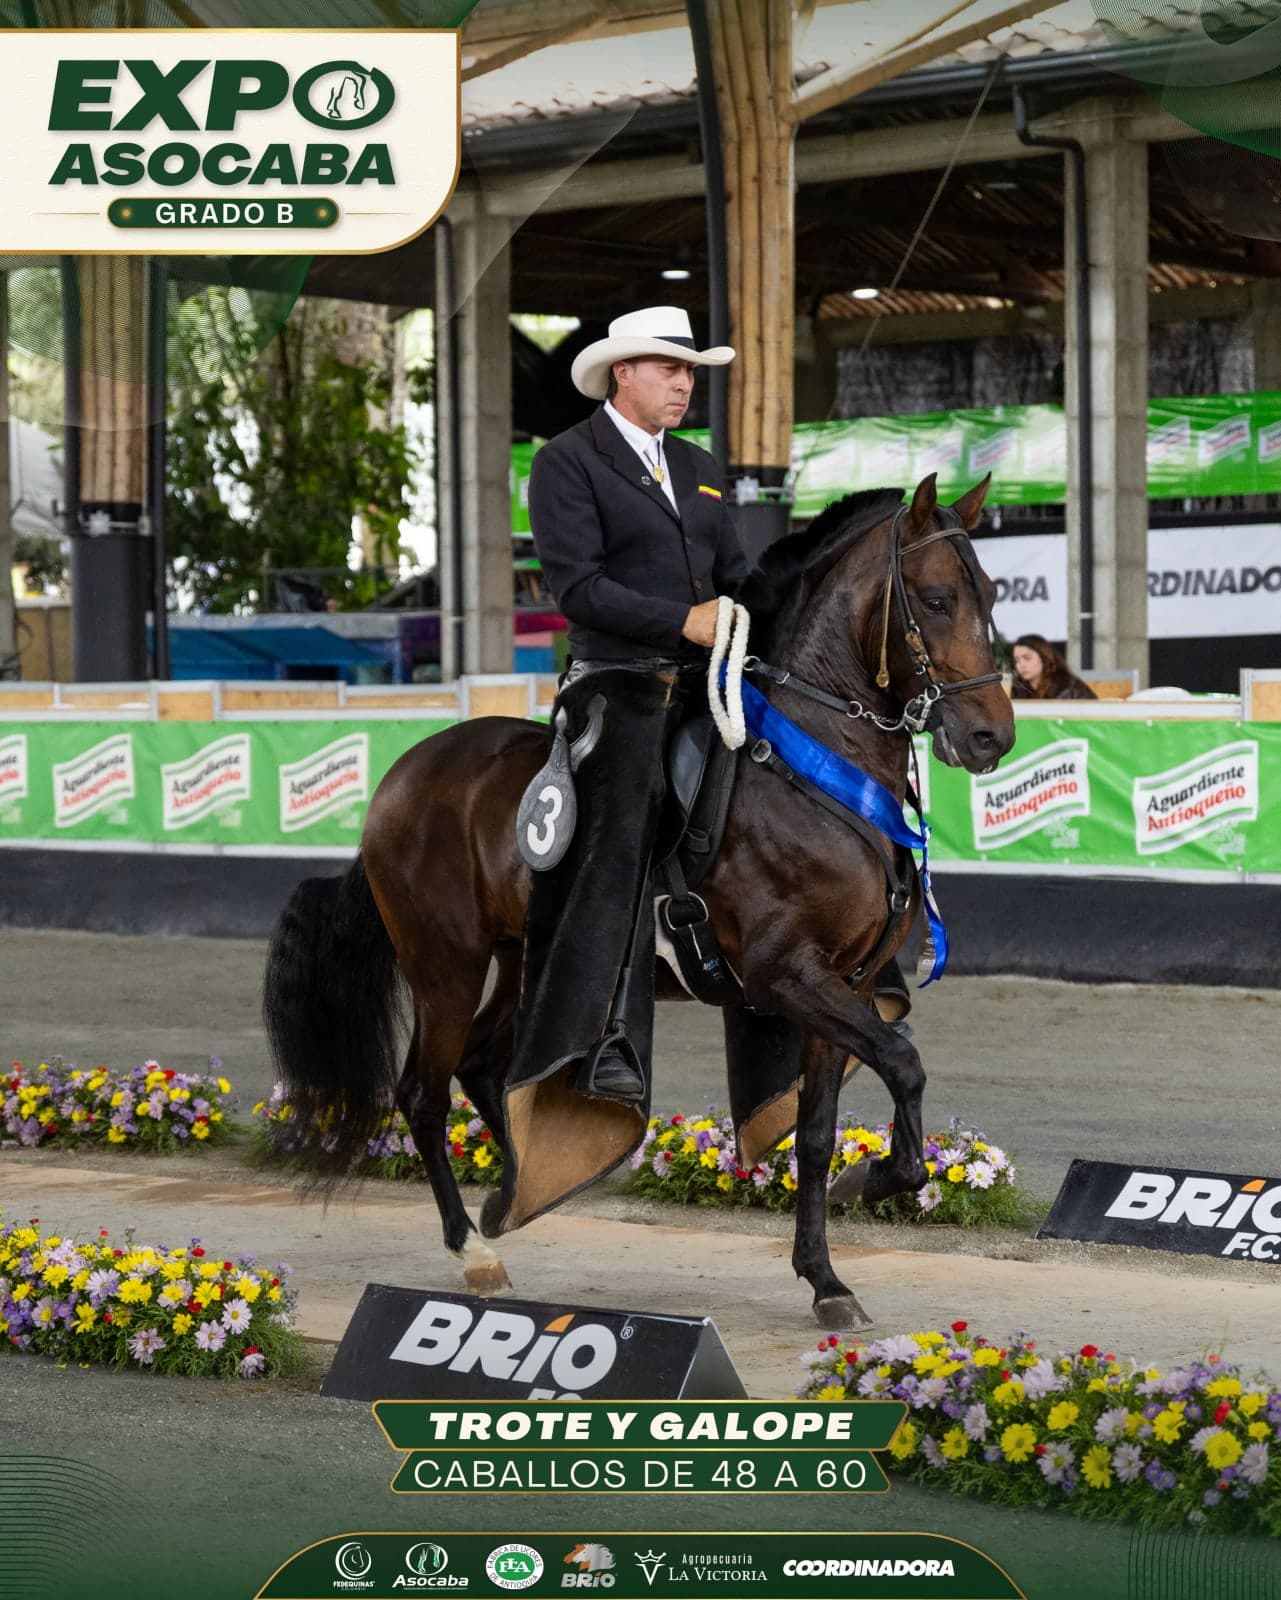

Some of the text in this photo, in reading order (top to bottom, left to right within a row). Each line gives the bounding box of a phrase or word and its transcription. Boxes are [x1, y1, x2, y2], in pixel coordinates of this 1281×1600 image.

[984, 762, 1076, 809] Aguardiente
[984, 778, 1079, 829] Antioqueño
[1146, 765, 1246, 813] Aguardiente
[1147, 781, 1247, 832] Antioqueño
[527, 785, 563, 855] 3
